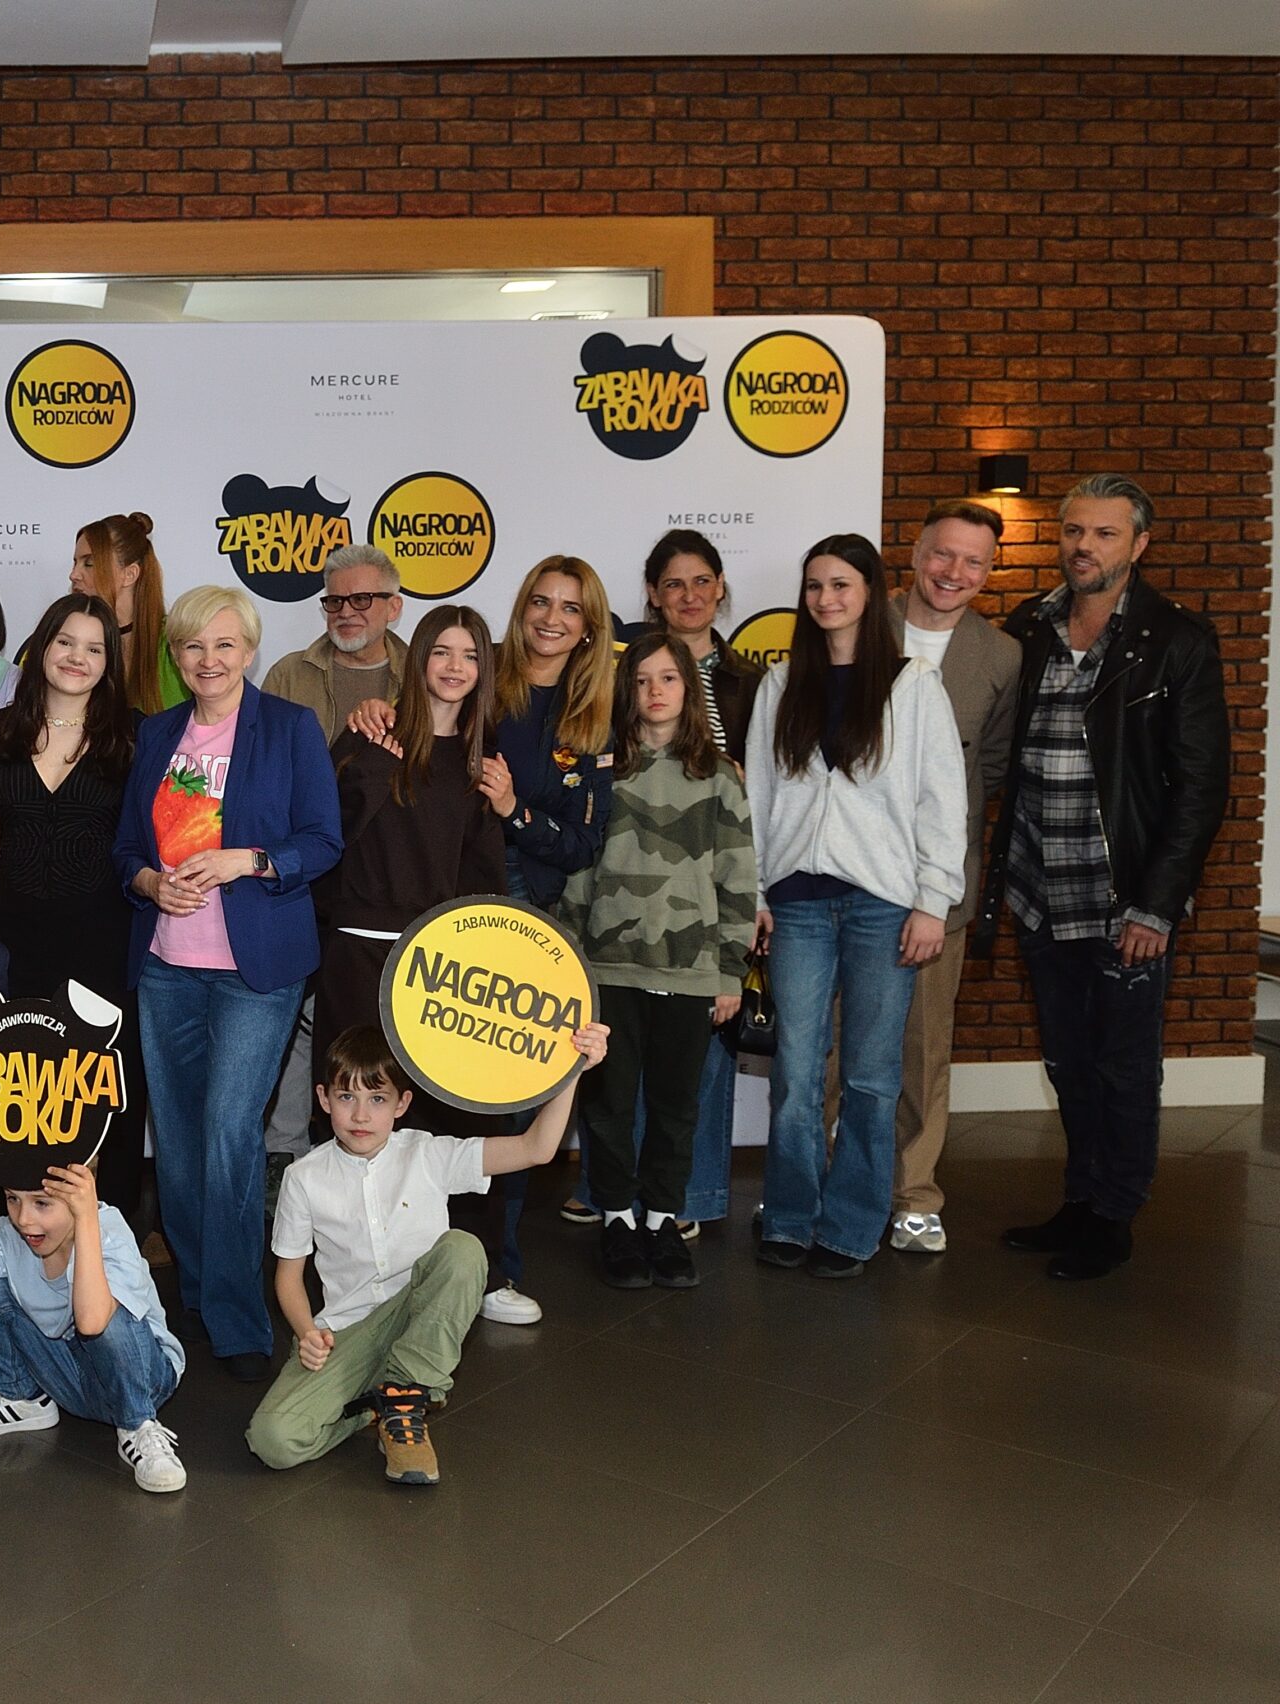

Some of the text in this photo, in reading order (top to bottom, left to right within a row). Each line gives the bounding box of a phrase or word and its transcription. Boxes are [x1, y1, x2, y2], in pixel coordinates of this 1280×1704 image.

[17, 380, 127, 407] NAGRODA
[310, 374, 400, 387] MERCURE
[576, 367, 707, 411] ZABAWKA
[735, 371, 840, 397] NAGRODA
[33, 407, 115, 426] RODZICÓW
[602, 399, 685, 433] ROKU
[749, 397, 829, 416] RODZICÓW
[218, 510, 351, 553] ZABAWKA
[380, 512, 487, 539] NAGRODA
[667, 512, 755, 525] MERCURE
[245, 541, 328, 575] ROKU
[394, 539, 475, 558] RODZICÓW
[452, 915, 565, 965] ZABAWKOWICZ.PL
[405, 945, 582, 1033] NAGRODA
[419, 998, 557, 1065] RODZICÓW
